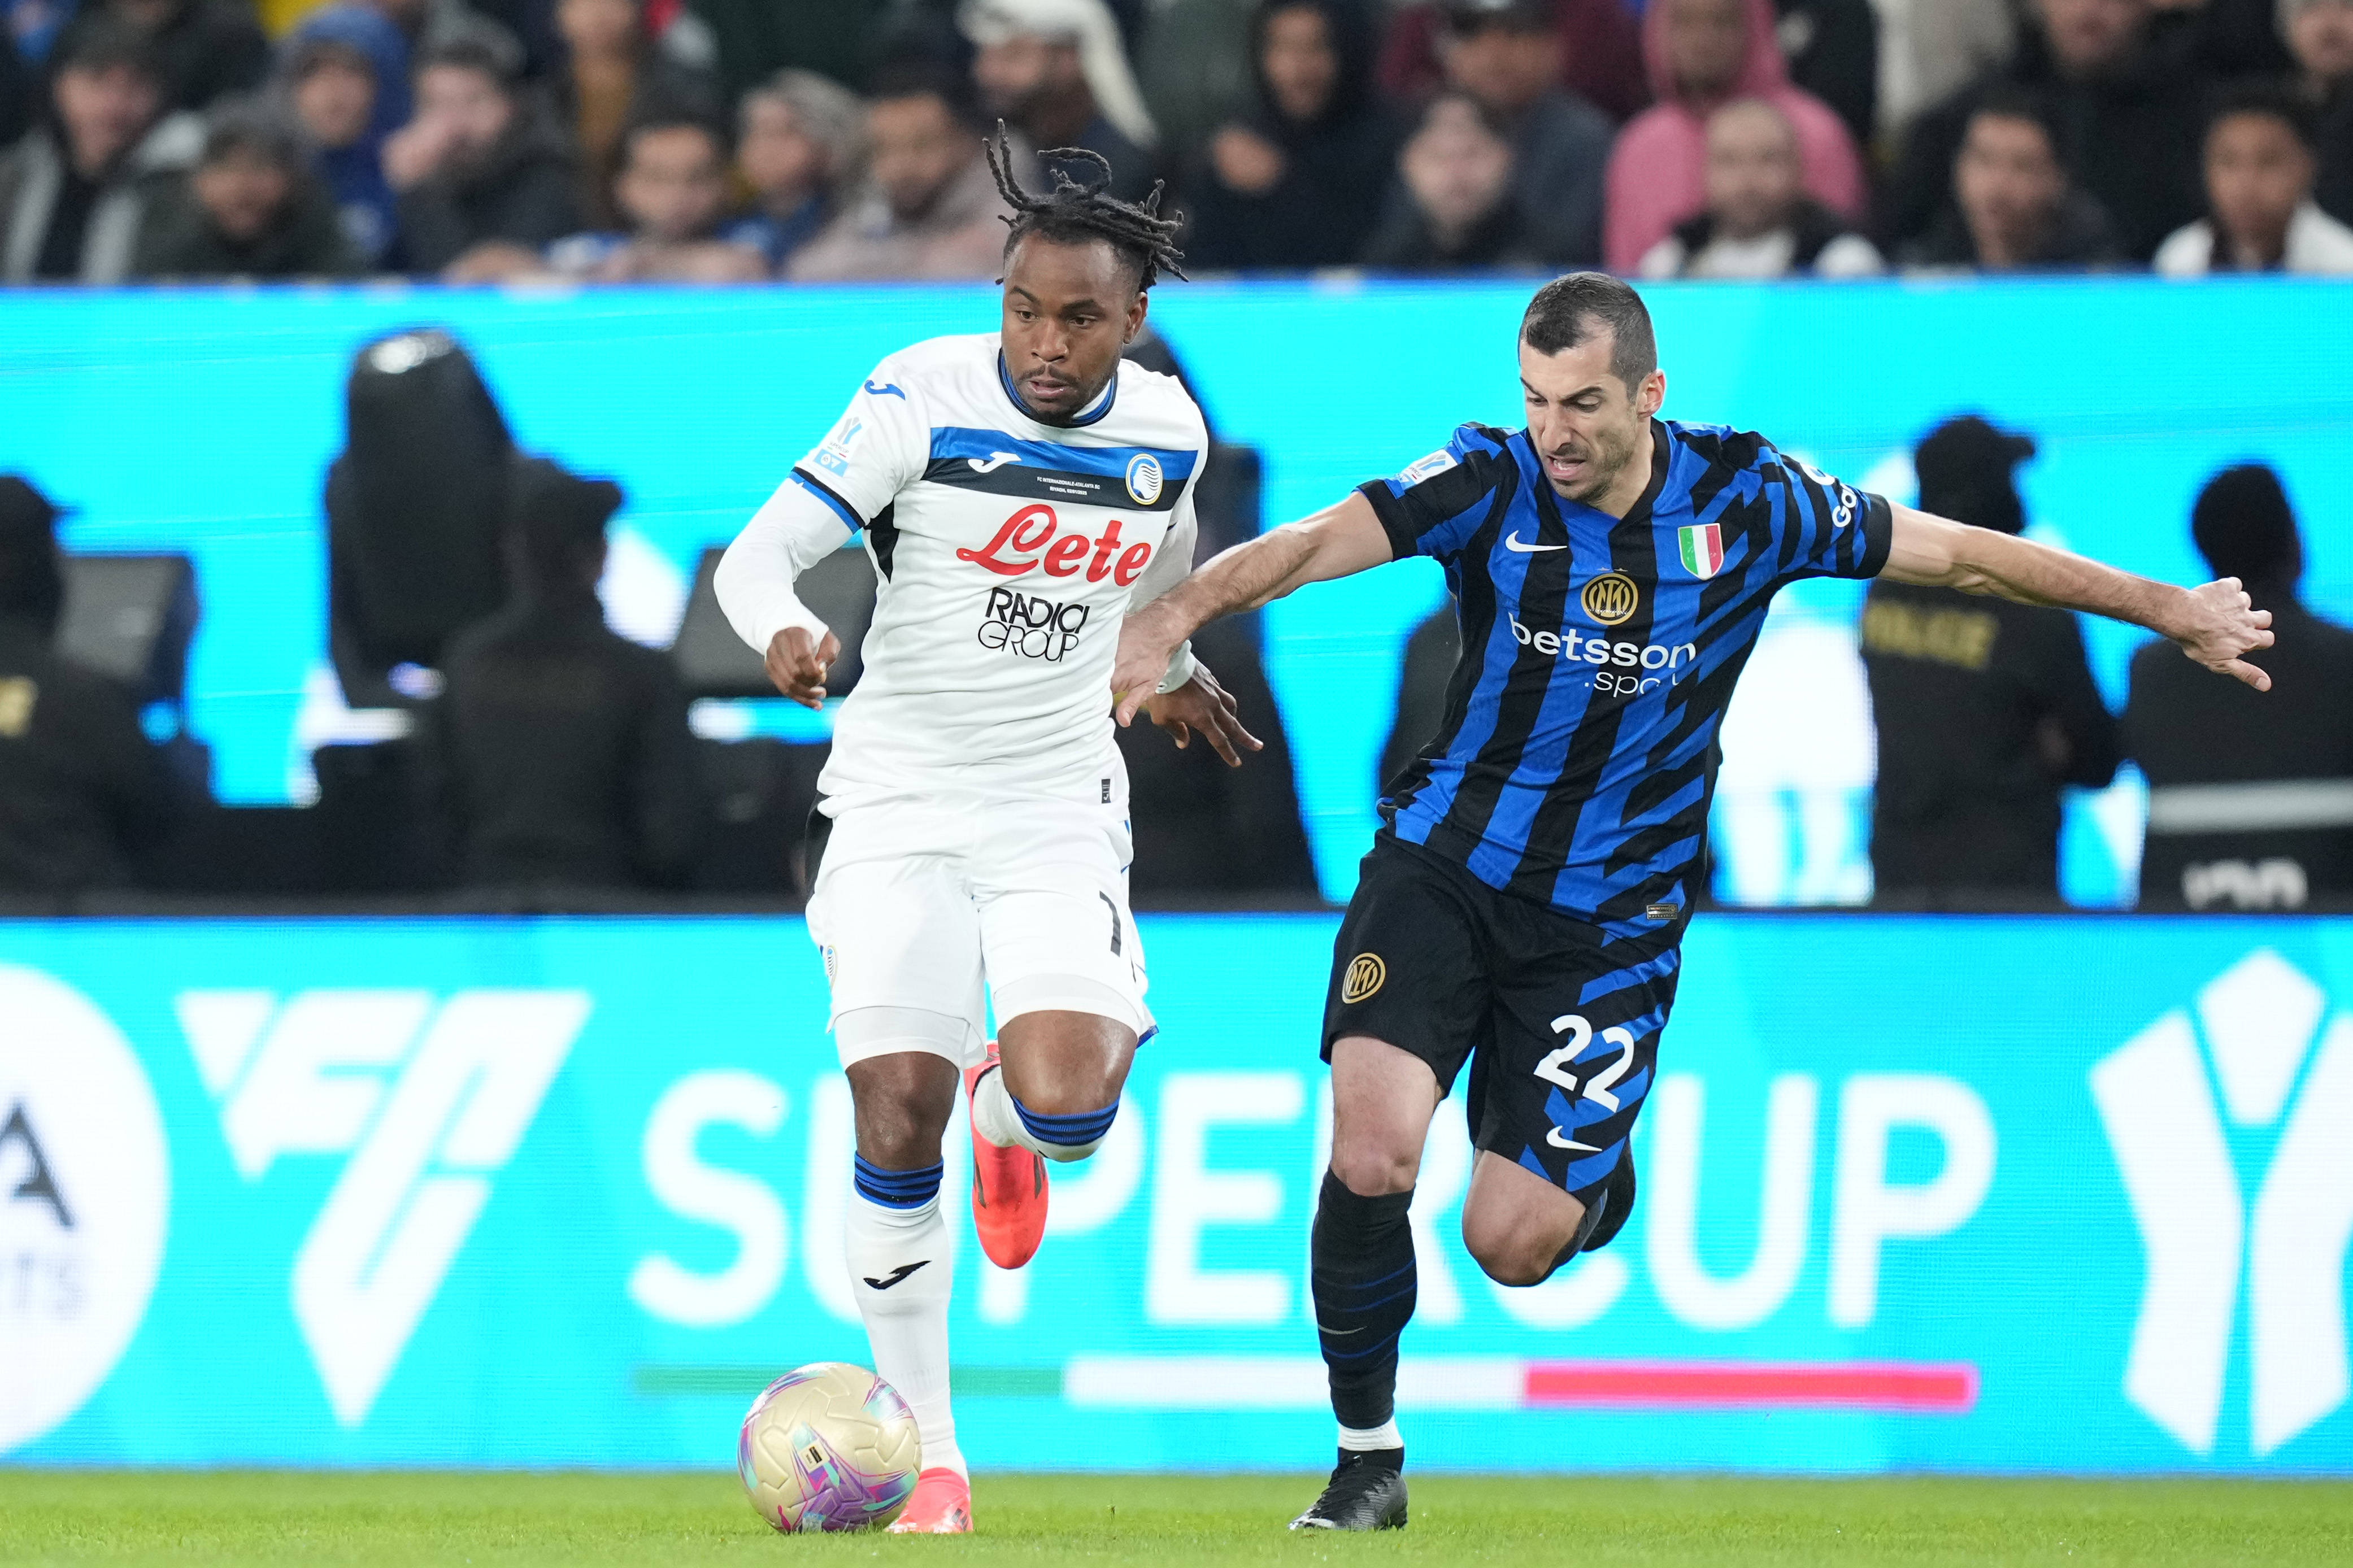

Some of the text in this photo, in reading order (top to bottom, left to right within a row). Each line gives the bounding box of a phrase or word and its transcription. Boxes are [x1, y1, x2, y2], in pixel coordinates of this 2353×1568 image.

[956, 503, 1151, 587] Lete
[985, 586, 1090, 634] RADICI
[977, 620, 1079, 663] GROUP
[1508, 612, 1696, 669] betsson
[1533, 1014, 1634, 1113] 22
